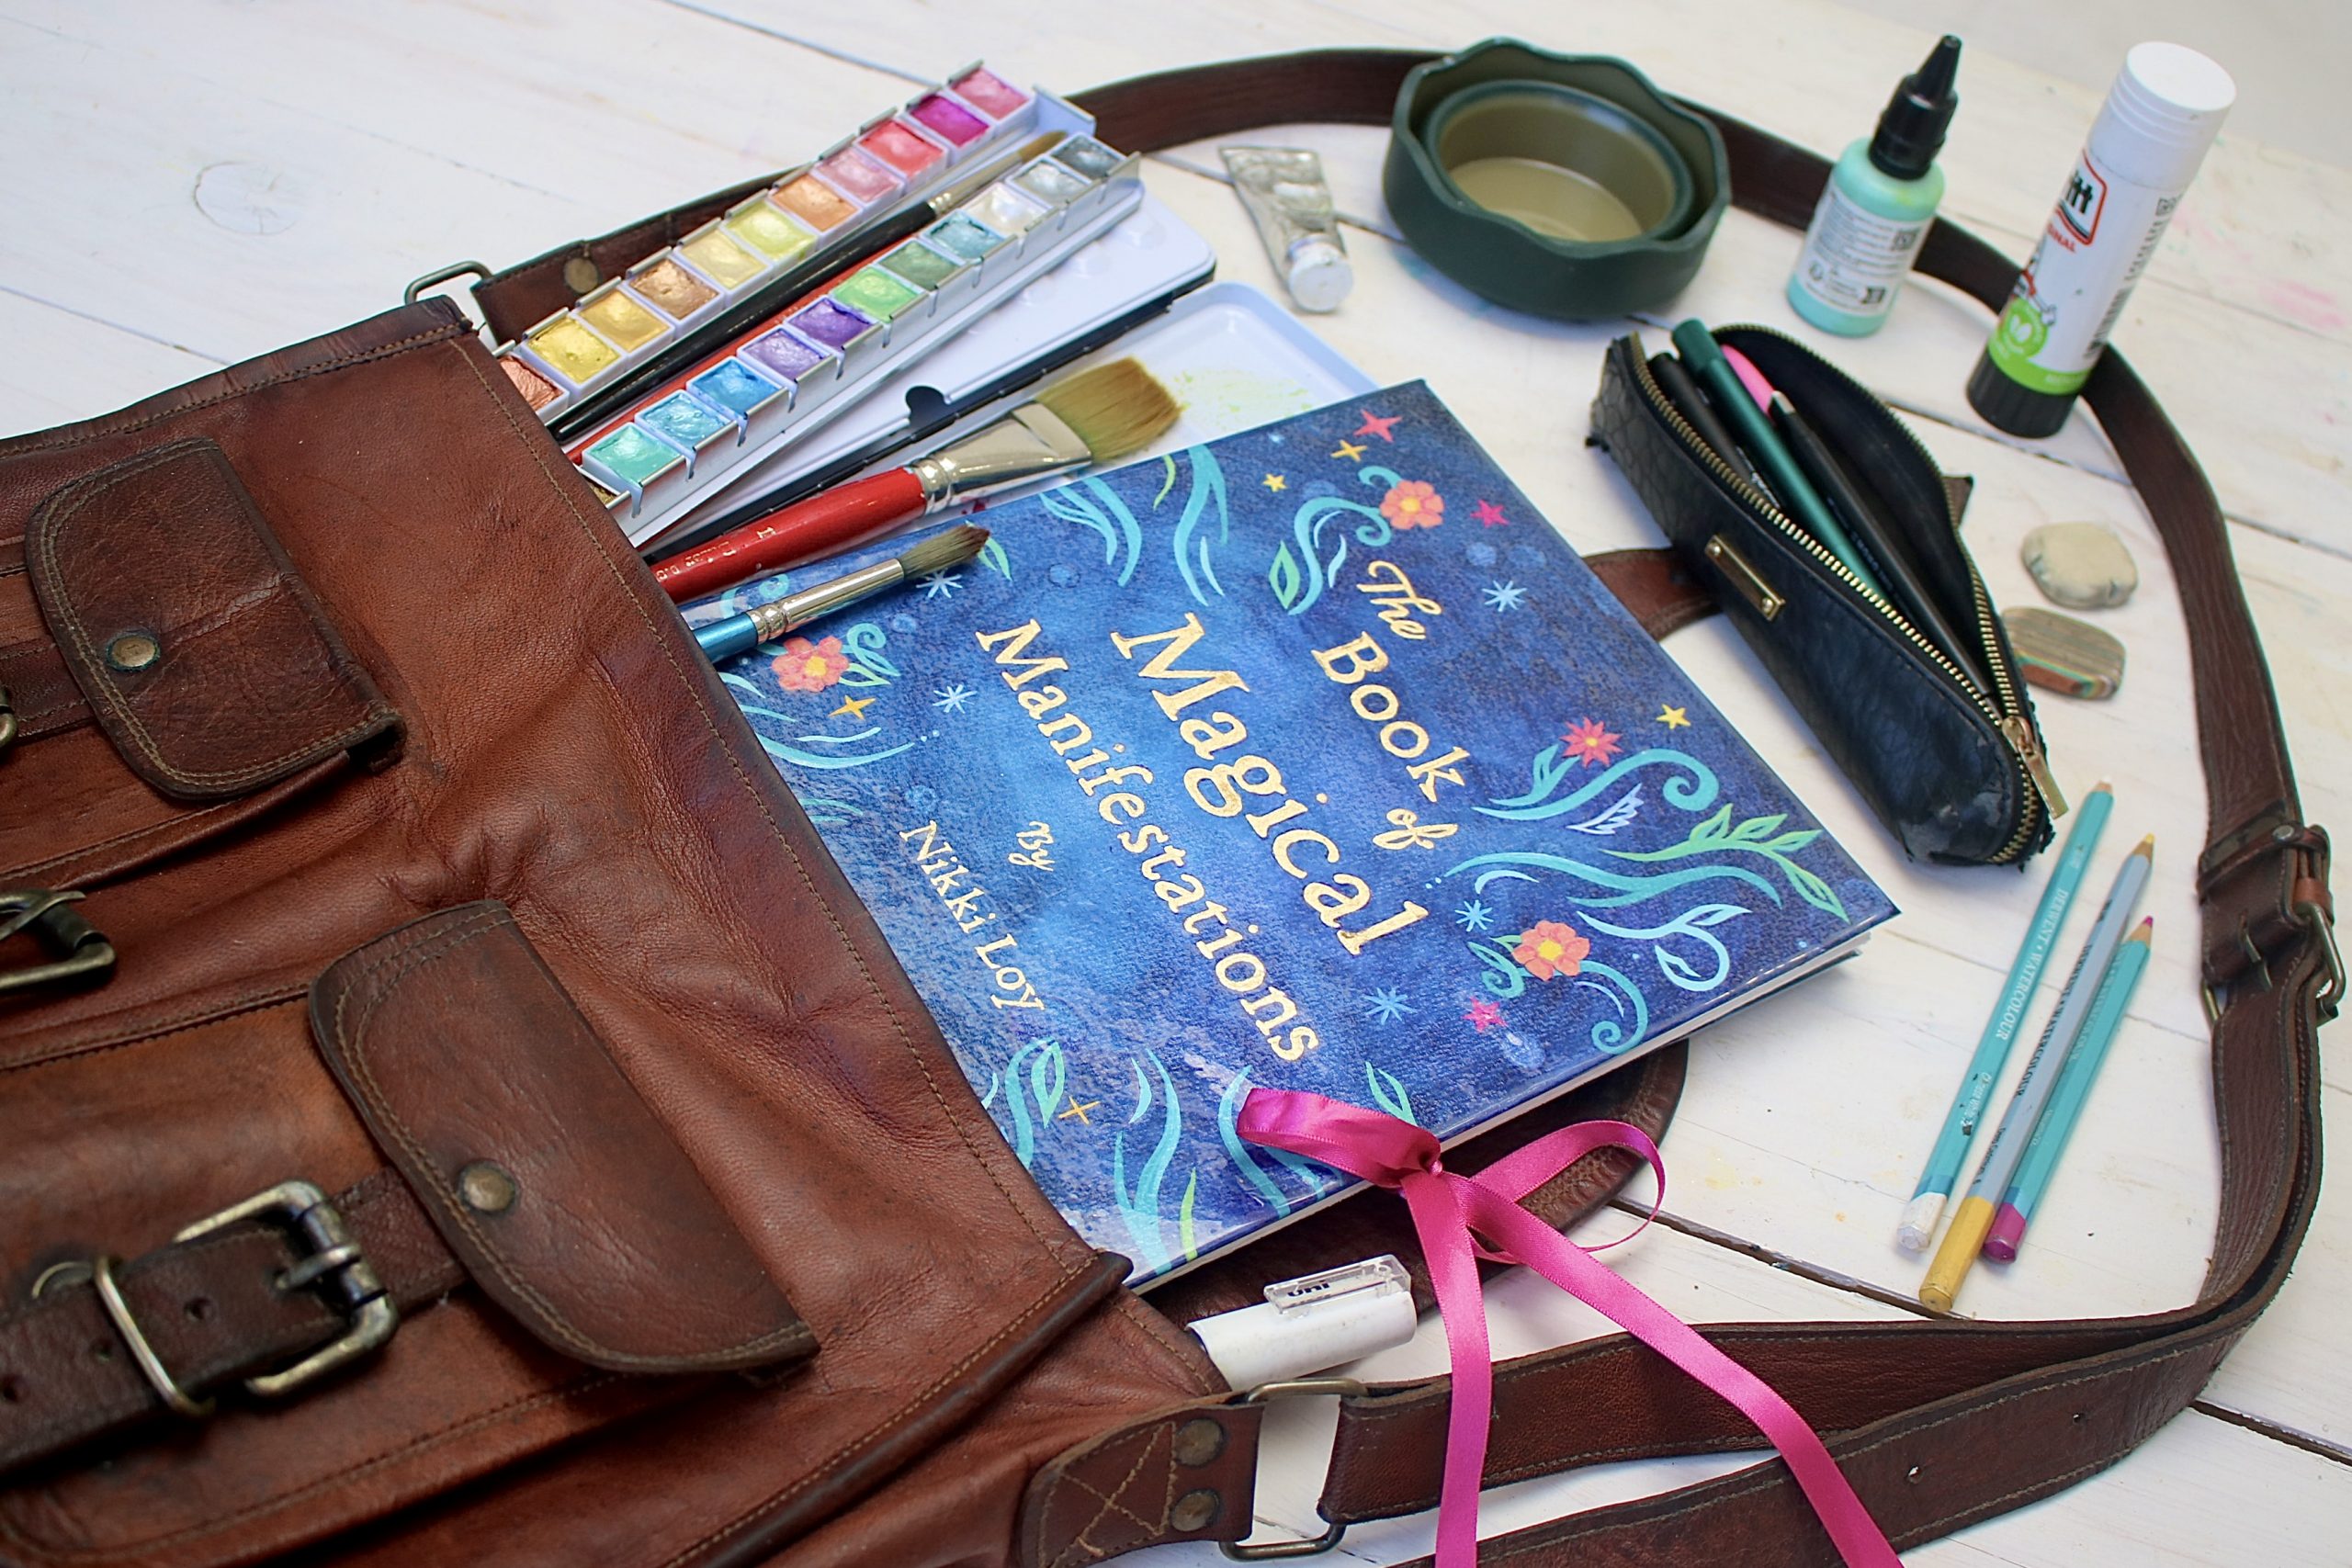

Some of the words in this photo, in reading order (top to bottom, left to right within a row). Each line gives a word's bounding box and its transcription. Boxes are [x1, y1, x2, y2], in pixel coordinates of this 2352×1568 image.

[1356, 559, 1443, 641] The
[1311, 631, 1468, 803] Book
[1110, 612, 1430, 955] Magical
[975, 618, 1320, 1063] Manifestations
[1007, 820, 1055, 872] By
[1372, 807, 1459, 852] of
[899, 819, 997, 934] Nikki
[975, 933, 1046, 1012] Loy
[2038, 886, 2070, 949] DERWENT
[1995, 951, 2044, 1041] WATERCOLOUR
